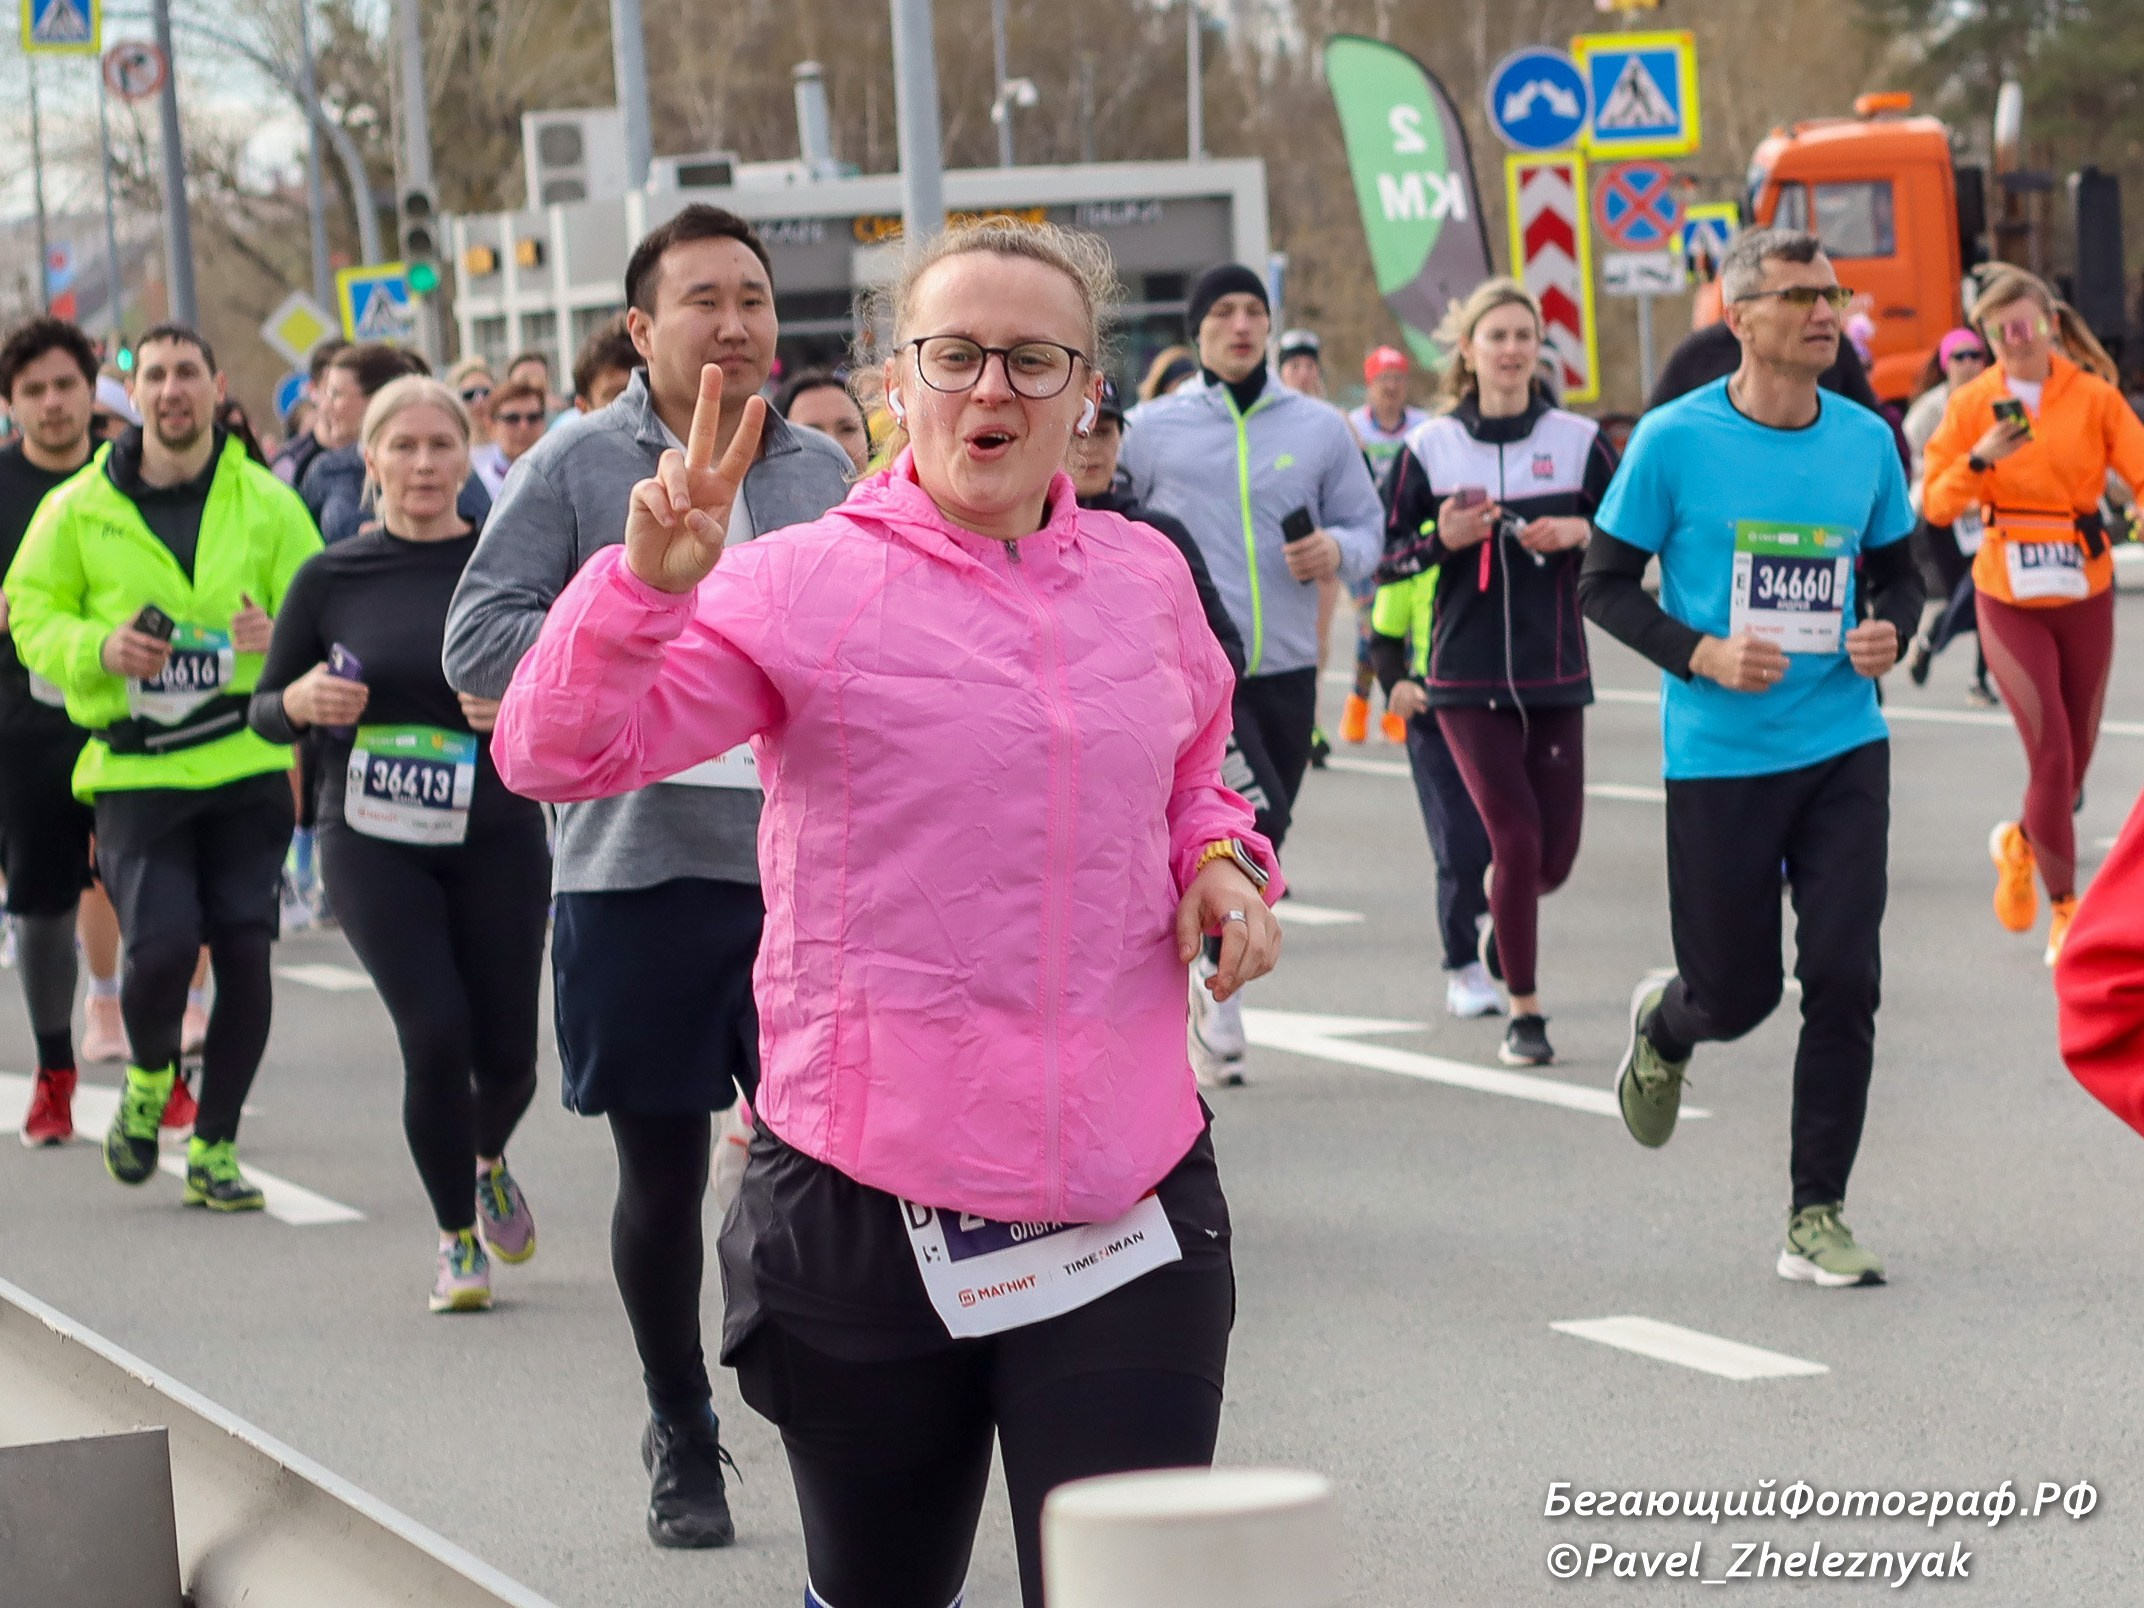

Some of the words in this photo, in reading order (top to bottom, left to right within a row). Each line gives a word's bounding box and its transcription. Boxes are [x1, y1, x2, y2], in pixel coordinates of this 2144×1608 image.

[1758, 564, 1832, 603] 34660
[148, 655, 216, 687] 6616
[371, 759, 451, 803] 36413
[906, 1203, 933, 1231] D
[977, 1275, 1037, 1300] МАГНИТ
